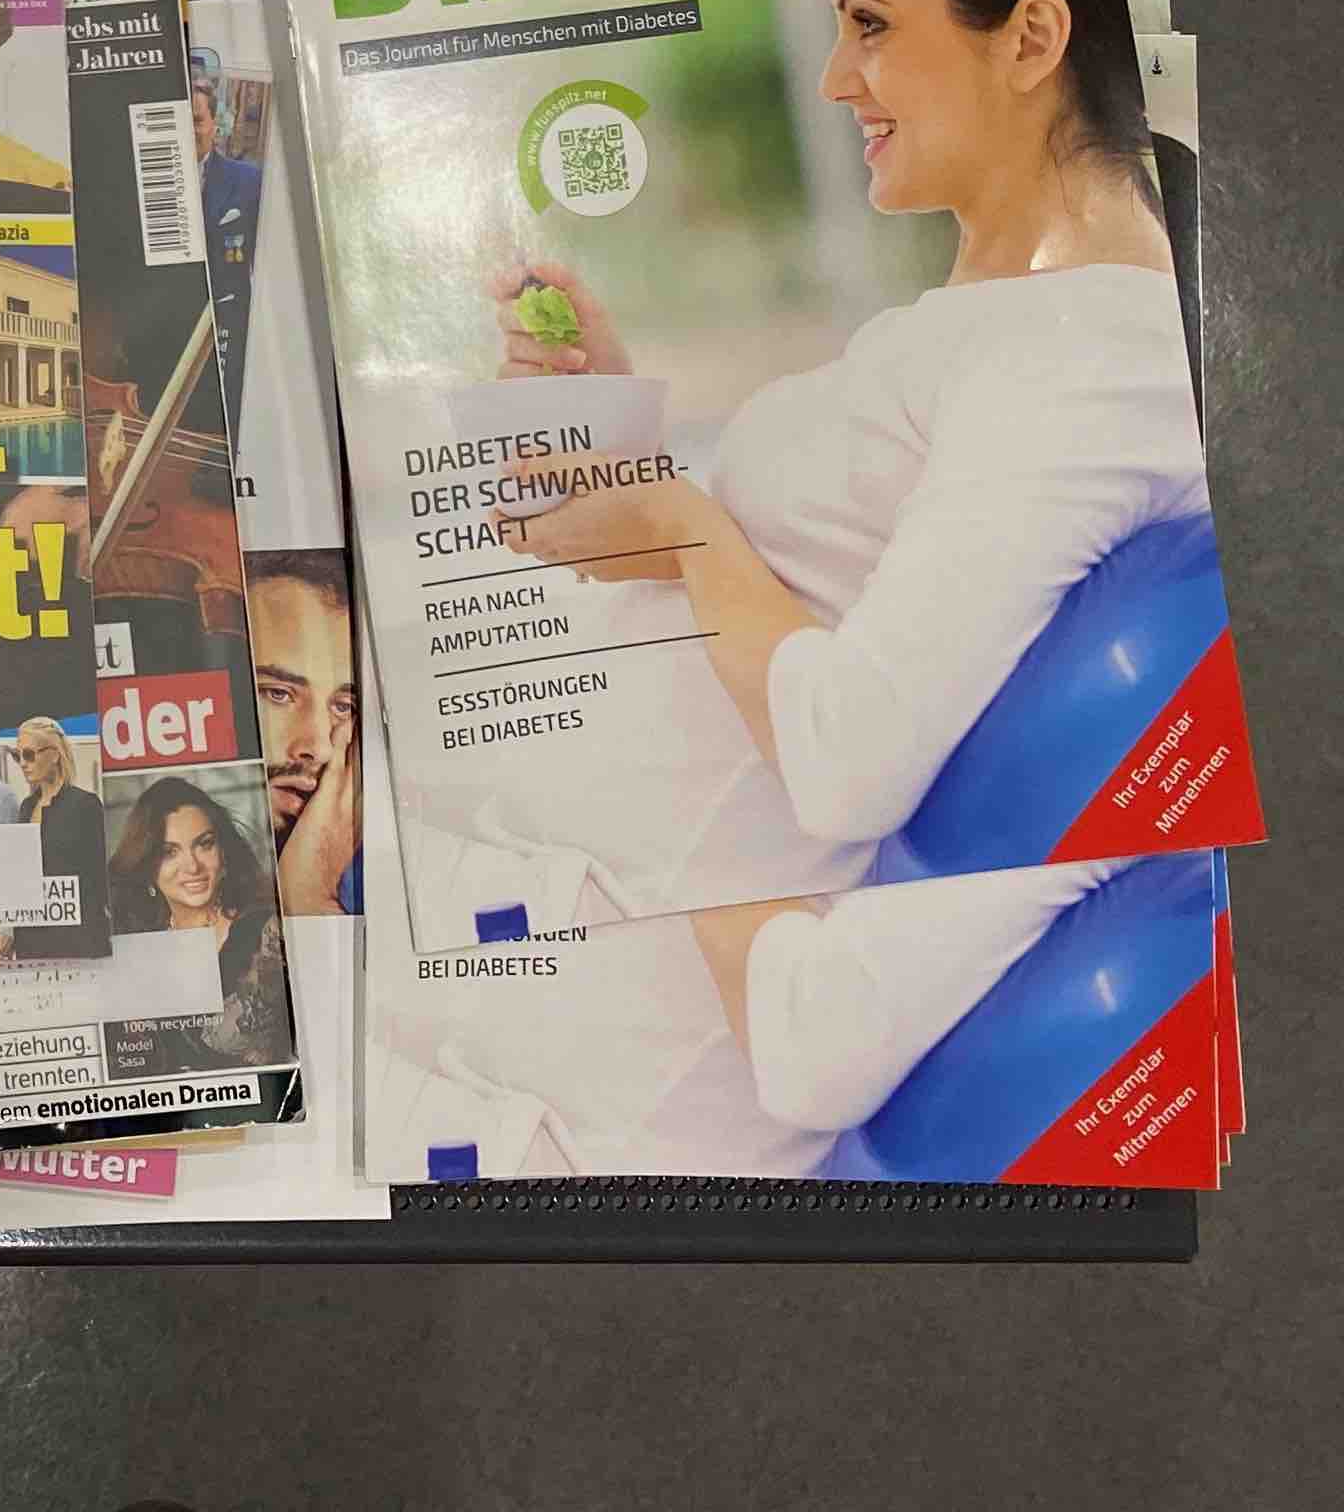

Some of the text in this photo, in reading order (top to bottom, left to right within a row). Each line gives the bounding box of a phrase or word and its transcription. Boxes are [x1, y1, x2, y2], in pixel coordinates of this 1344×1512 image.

[346, 8, 697, 67] Das Journal für Menschen mit Diabetes
[405, 425, 592, 476] DIABETES IN
[412, 455, 689, 517] DER SCHWANGER-
[416, 519, 528, 558] SCHAFT
[426, 586, 544, 622] REHA NACH
[431, 616, 569, 656] AMPUTATION
[439, 672, 607, 716] ESSSTÖRUNGEN
[443, 710, 584, 750] BEI DIABETES
[1112, 710, 1194, 808] Ihr Exemplar
[1159, 758, 1191, 794] zum
[1156, 746, 1231, 834] Mitnehmen
[419, 956, 557, 979] BEI DIABETES
[38, 1090, 174, 1119] emotionalen
[179, 1080, 251, 1105] Drama
